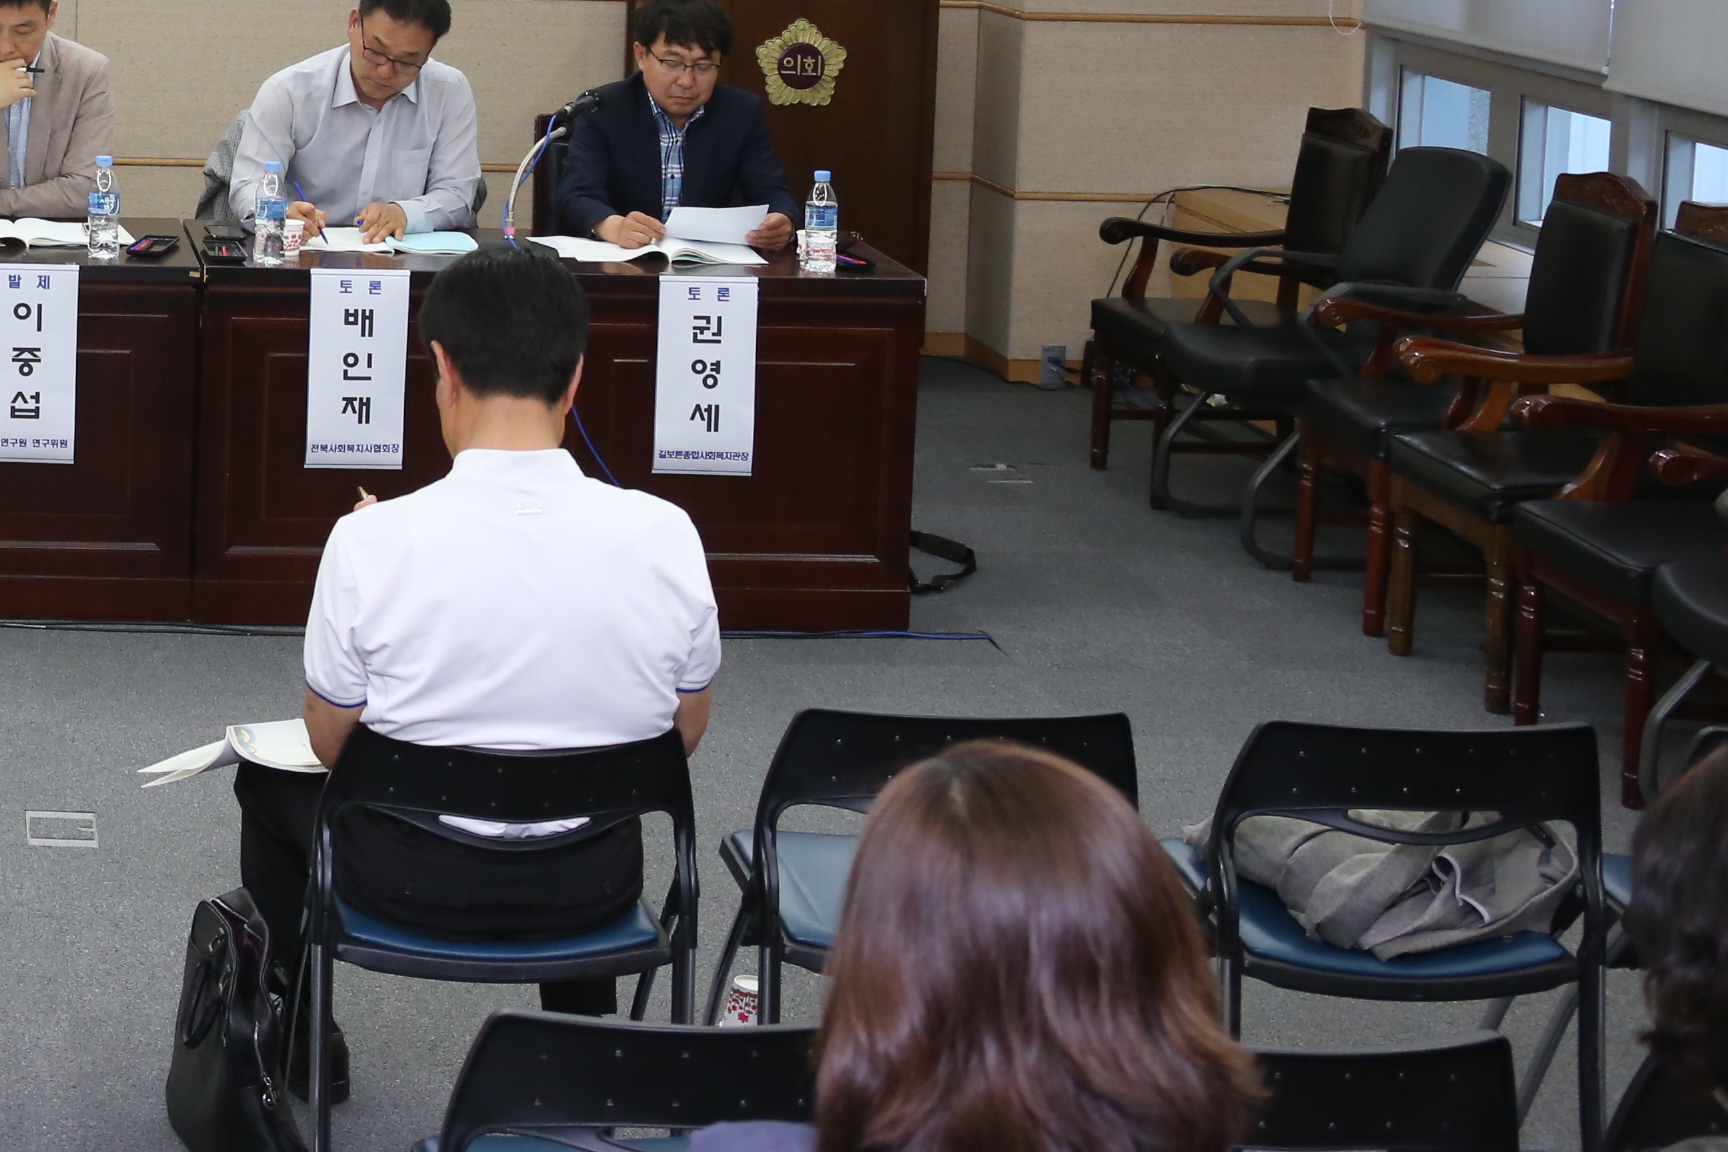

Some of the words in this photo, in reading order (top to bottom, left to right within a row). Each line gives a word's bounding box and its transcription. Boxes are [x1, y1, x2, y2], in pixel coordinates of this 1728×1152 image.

[780, 54, 822, 77] 의회
[9, 302, 43, 420] 이중섭
[341, 308, 375, 425] 배인재
[689, 315, 723, 433] 권영세
[32, 438, 69, 449] 연구위원
[310, 443, 400, 454] 전북사회복지사협회장
